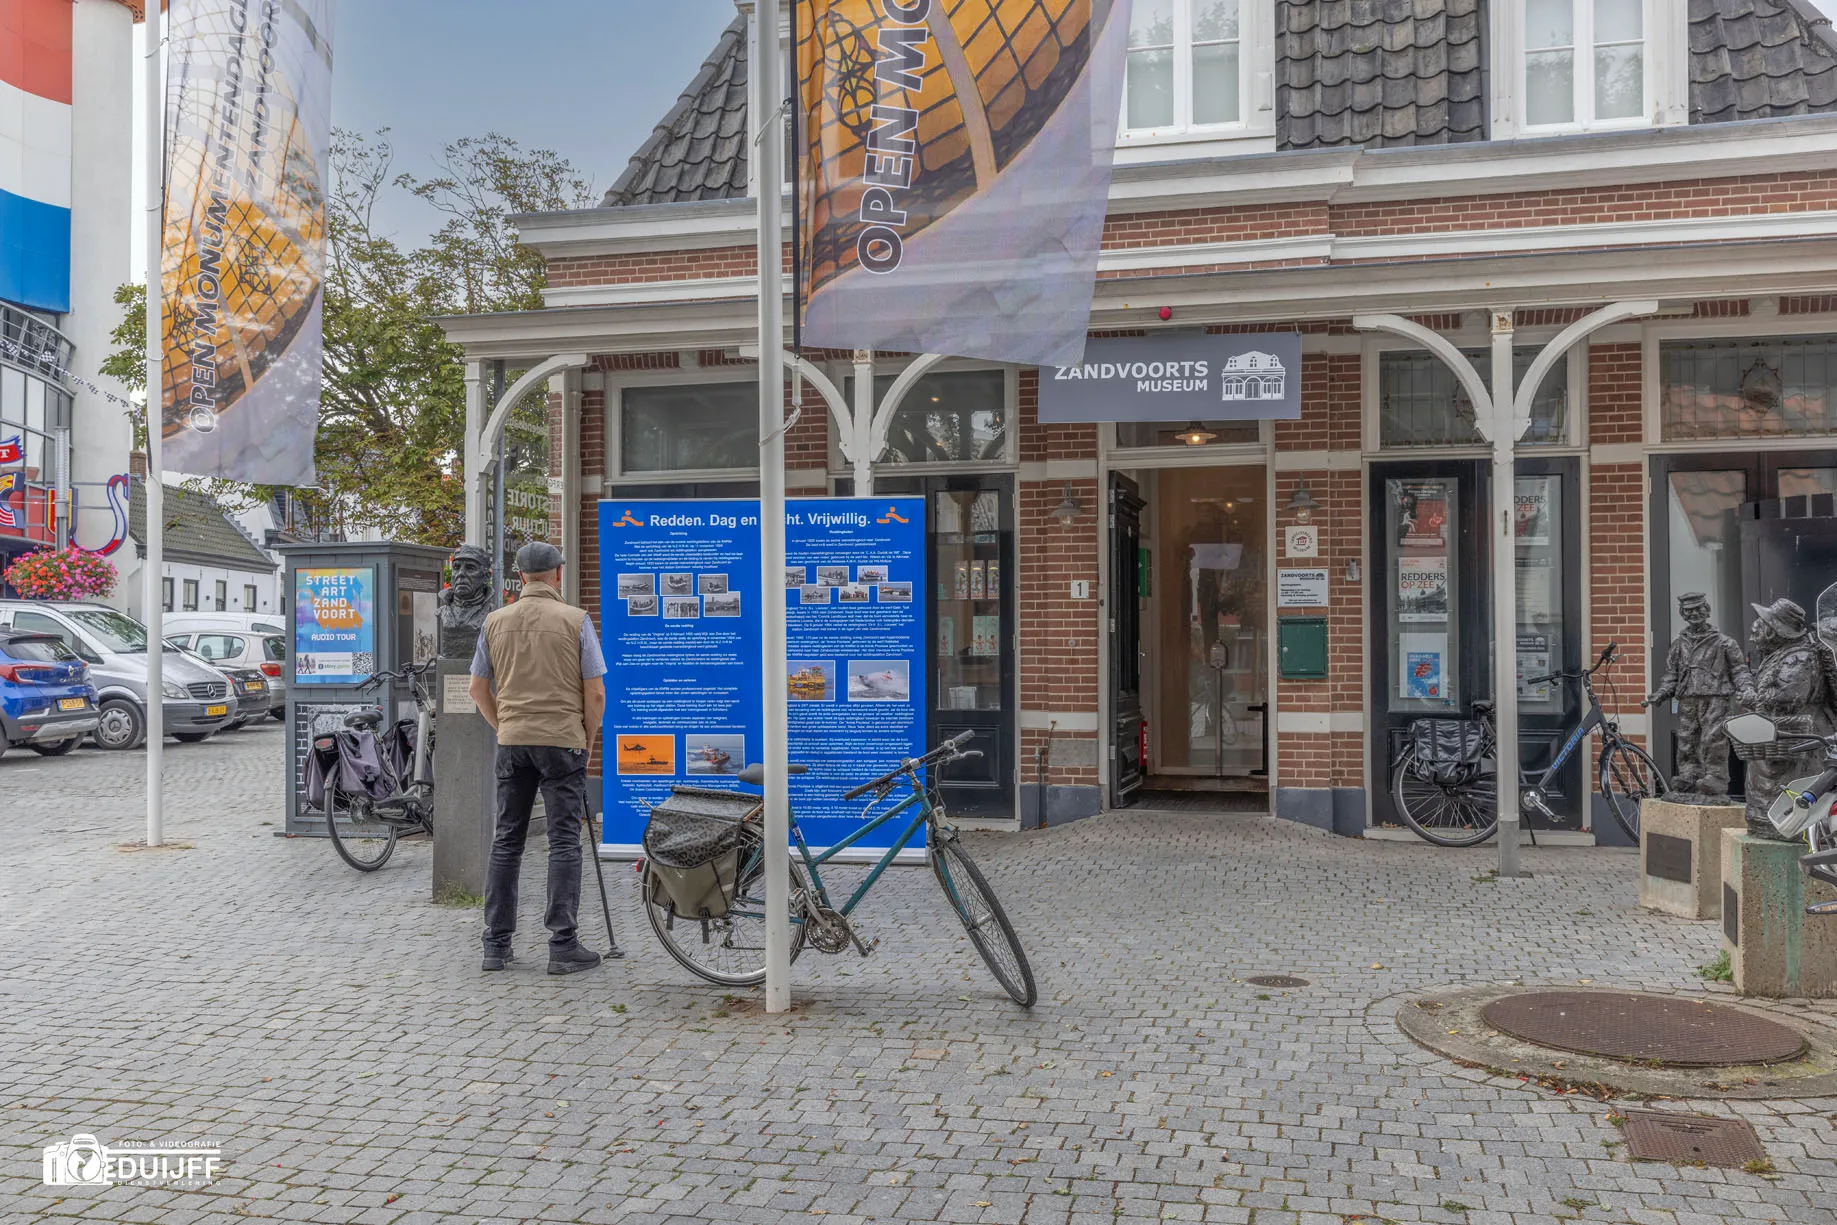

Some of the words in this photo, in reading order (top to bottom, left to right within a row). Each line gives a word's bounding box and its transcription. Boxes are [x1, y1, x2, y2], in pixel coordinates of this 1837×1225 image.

[244, 0, 281, 192] ZANDVOOR
[856, 104, 919, 276] OPEN
[1054, 361, 1209, 380] ZANDVOORTS
[189, 341, 217, 434] OPEN
[1136, 379, 1208, 392] MUSEUM
[1514, 495, 1546, 504] DDERS
[1517, 503, 1535, 512] ZEE
[649, 513, 706, 527] Redden.
[709, 513, 737, 529] Dag
[740, 516, 758, 527] en
[807, 512, 871, 528] Vrijwillig.
[306, 575, 355, 585] STREET
[1401, 572, 1446, 581] REDDERS
[1077, 582, 1083, 597] 1
[1401, 580, 1415, 589] OP
[1417, 580, 1435, 589] ZEE
[321, 586, 347, 596] ART
[314, 597, 347, 608] ZAND
[313, 608, 355, 619] VOORT
[311, 633, 335, 641] AUDIO
[336, 633, 356, 641] TOUR
[1552, 727, 1585, 770] VICTORIA
